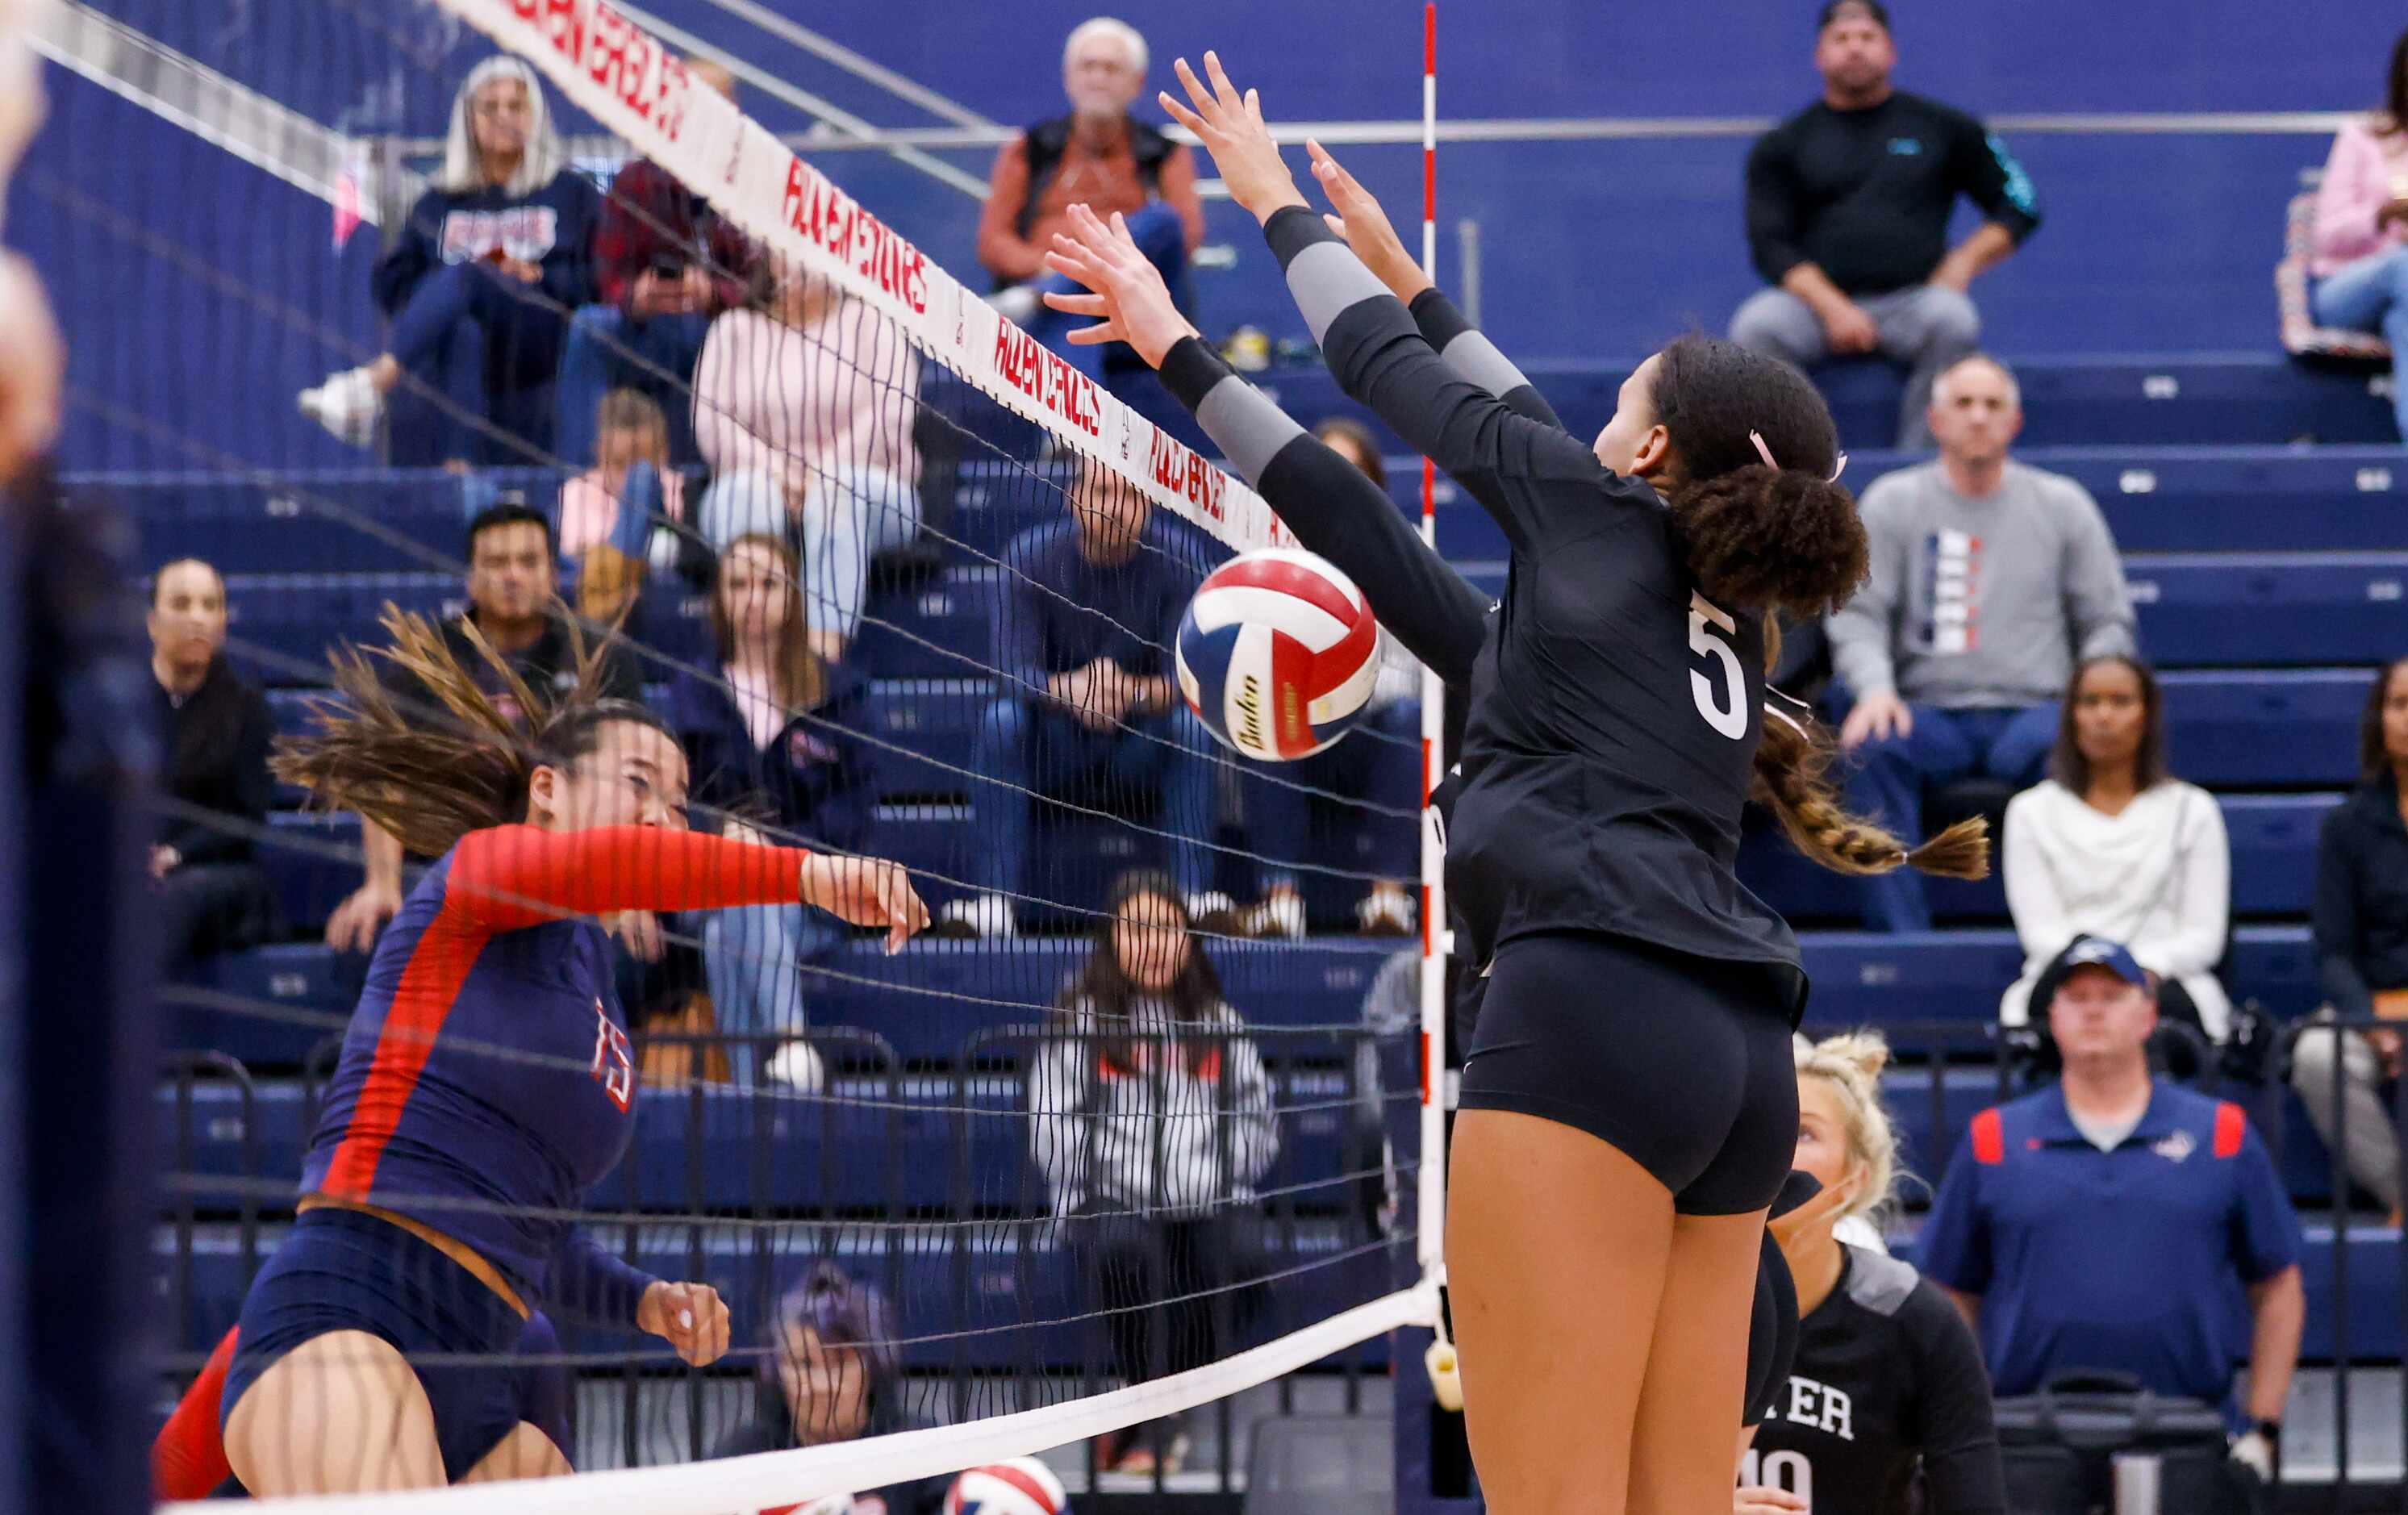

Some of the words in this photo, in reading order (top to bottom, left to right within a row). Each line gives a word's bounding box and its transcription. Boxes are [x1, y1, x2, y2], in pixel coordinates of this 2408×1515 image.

[994, 314, 1044, 403] ALLEN
[1688, 586, 1749, 741] 5
[1764, 1375, 1855, 1442] ER
